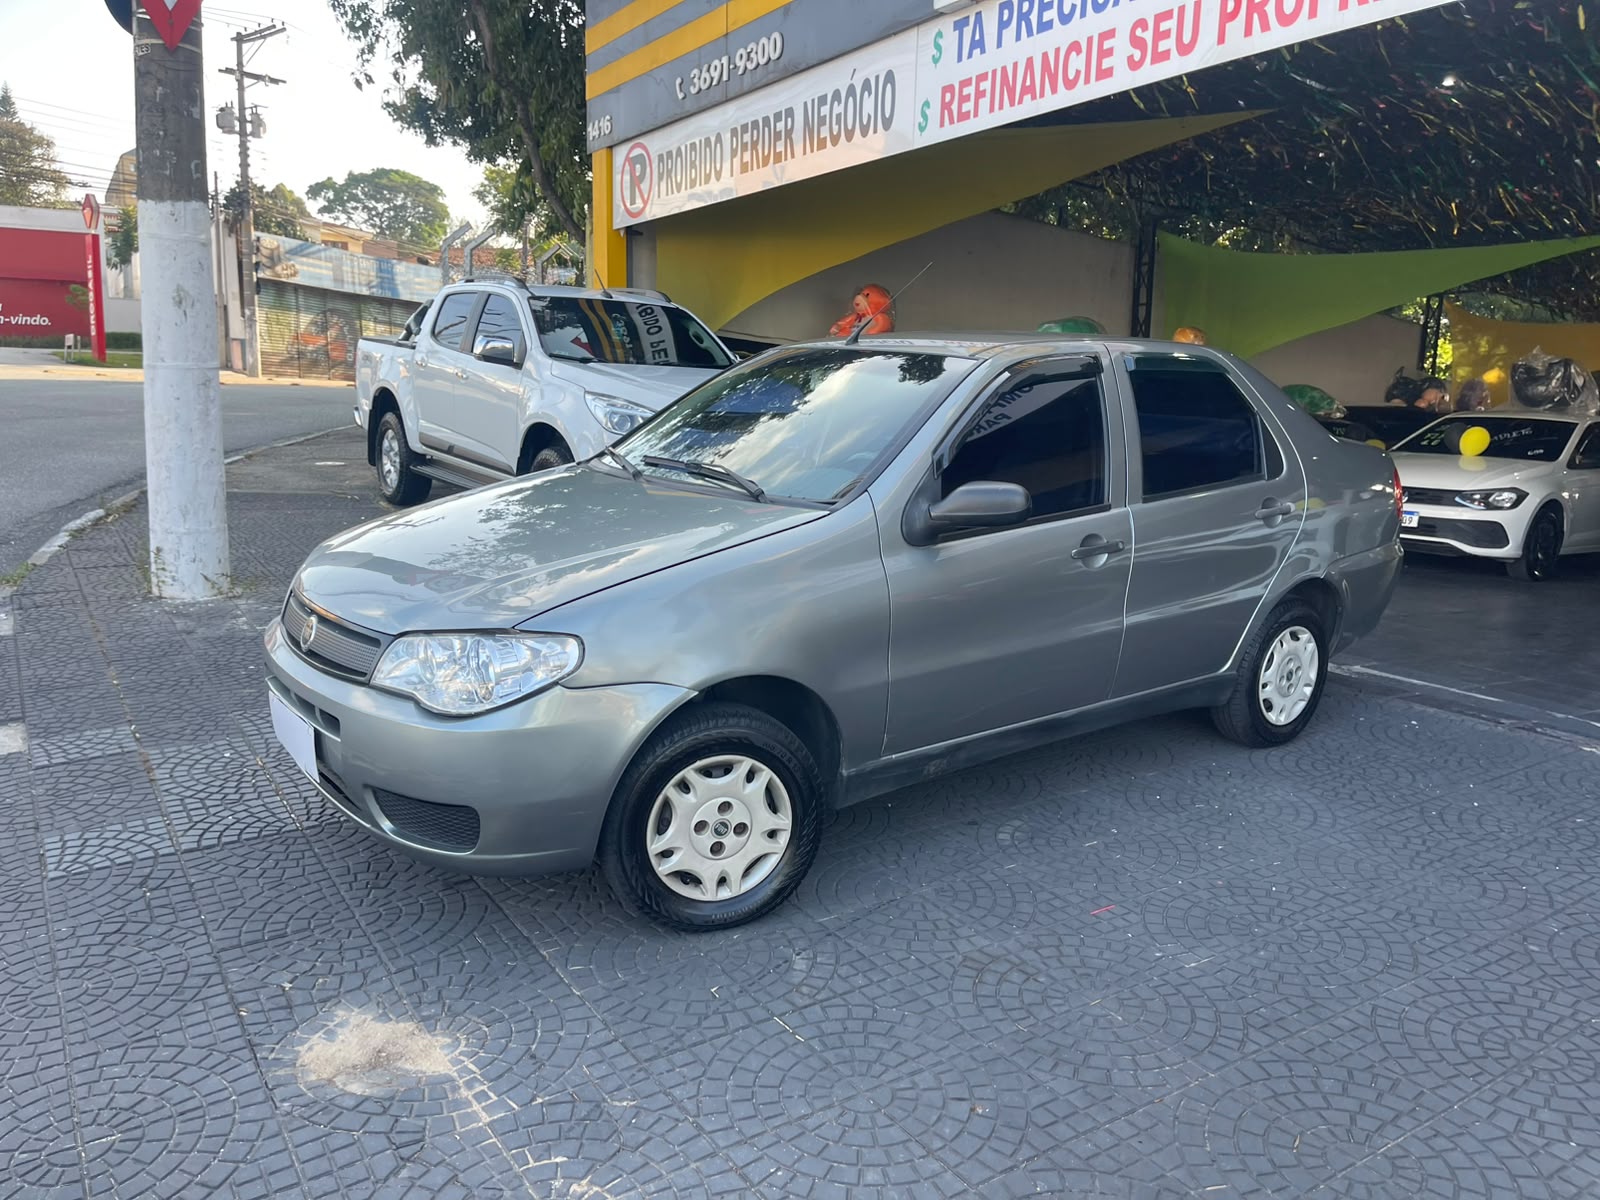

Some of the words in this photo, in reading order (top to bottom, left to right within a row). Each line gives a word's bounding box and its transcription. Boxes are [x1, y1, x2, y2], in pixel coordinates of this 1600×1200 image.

[689, 31, 784, 96] 3691-9300
[939, 27, 1117, 129] REFINANCIE
[1126, 0, 1201, 72] SEU
[953, 10, 987, 63] TA
[587, 114, 613, 142] 1416
[657, 132, 724, 199] PROIBIDO
[730, 106, 795, 178] PERDER
[803, 68, 897, 156] NEGÓCIO
